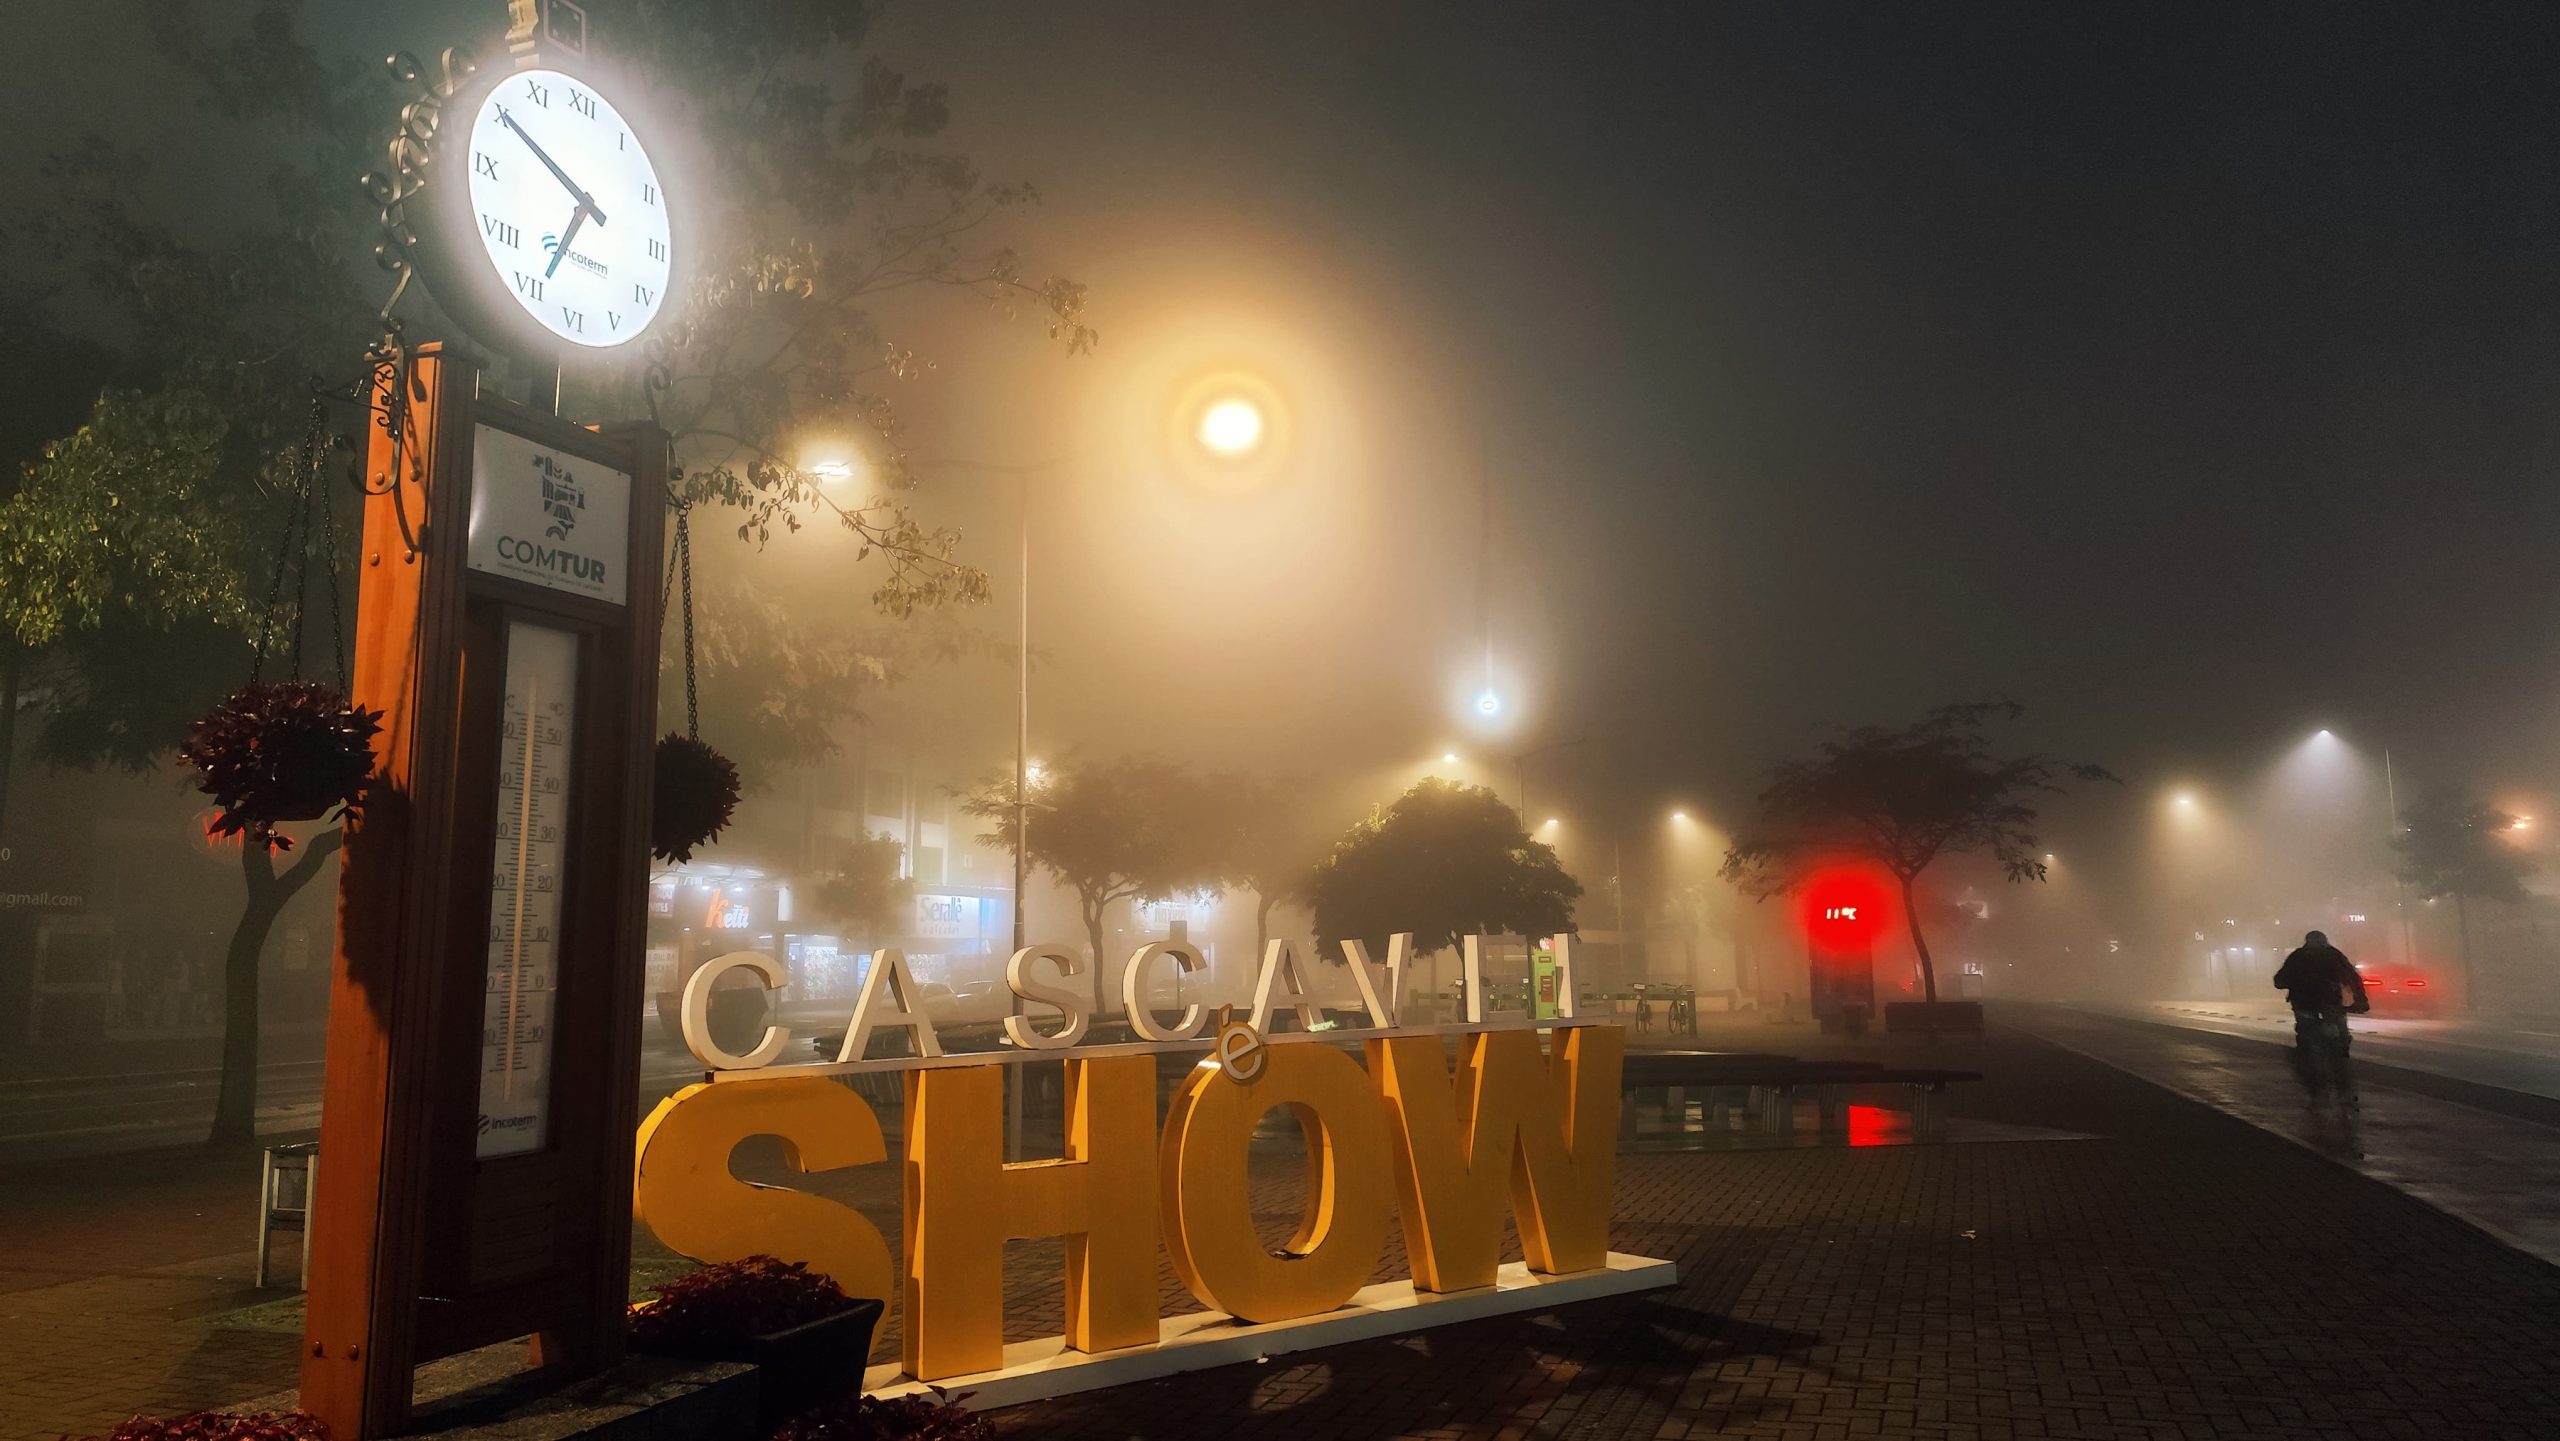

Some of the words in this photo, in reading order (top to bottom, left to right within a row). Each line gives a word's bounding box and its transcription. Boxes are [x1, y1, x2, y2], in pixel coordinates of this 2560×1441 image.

[526, 79, 549, 109] XI
[568, 87, 596, 120] XII
[493, 102, 509, 129] X
[619, 131, 625, 152] I
[475, 151, 499, 182] IX
[644, 183, 655, 206] II
[482, 213, 520, 250] VIII
[564, 248, 608, 275] ncoterm
[648, 238, 666, 263] III
[514, 270, 544, 302] VII
[635, 283, 654, 308] IV
[562, 306, 584, 334] VI
[608, 310, 621, 332] V
[497, 535, 606, 584] COMTUR
[547, 728, 562, 744] 50
[544, 776, 559, 791] 40
[541, 825, 556, 841] 30
[538, 875, 553, 890] 20
[2348, 914, 2366, 922] TIM
[536, 926, 549, 941] 10
[535, 975, 544, 988] 0
[680, 932, 1611, 1072] CASCAVEL
[635, 1025, 1625, 1383] SHOW
